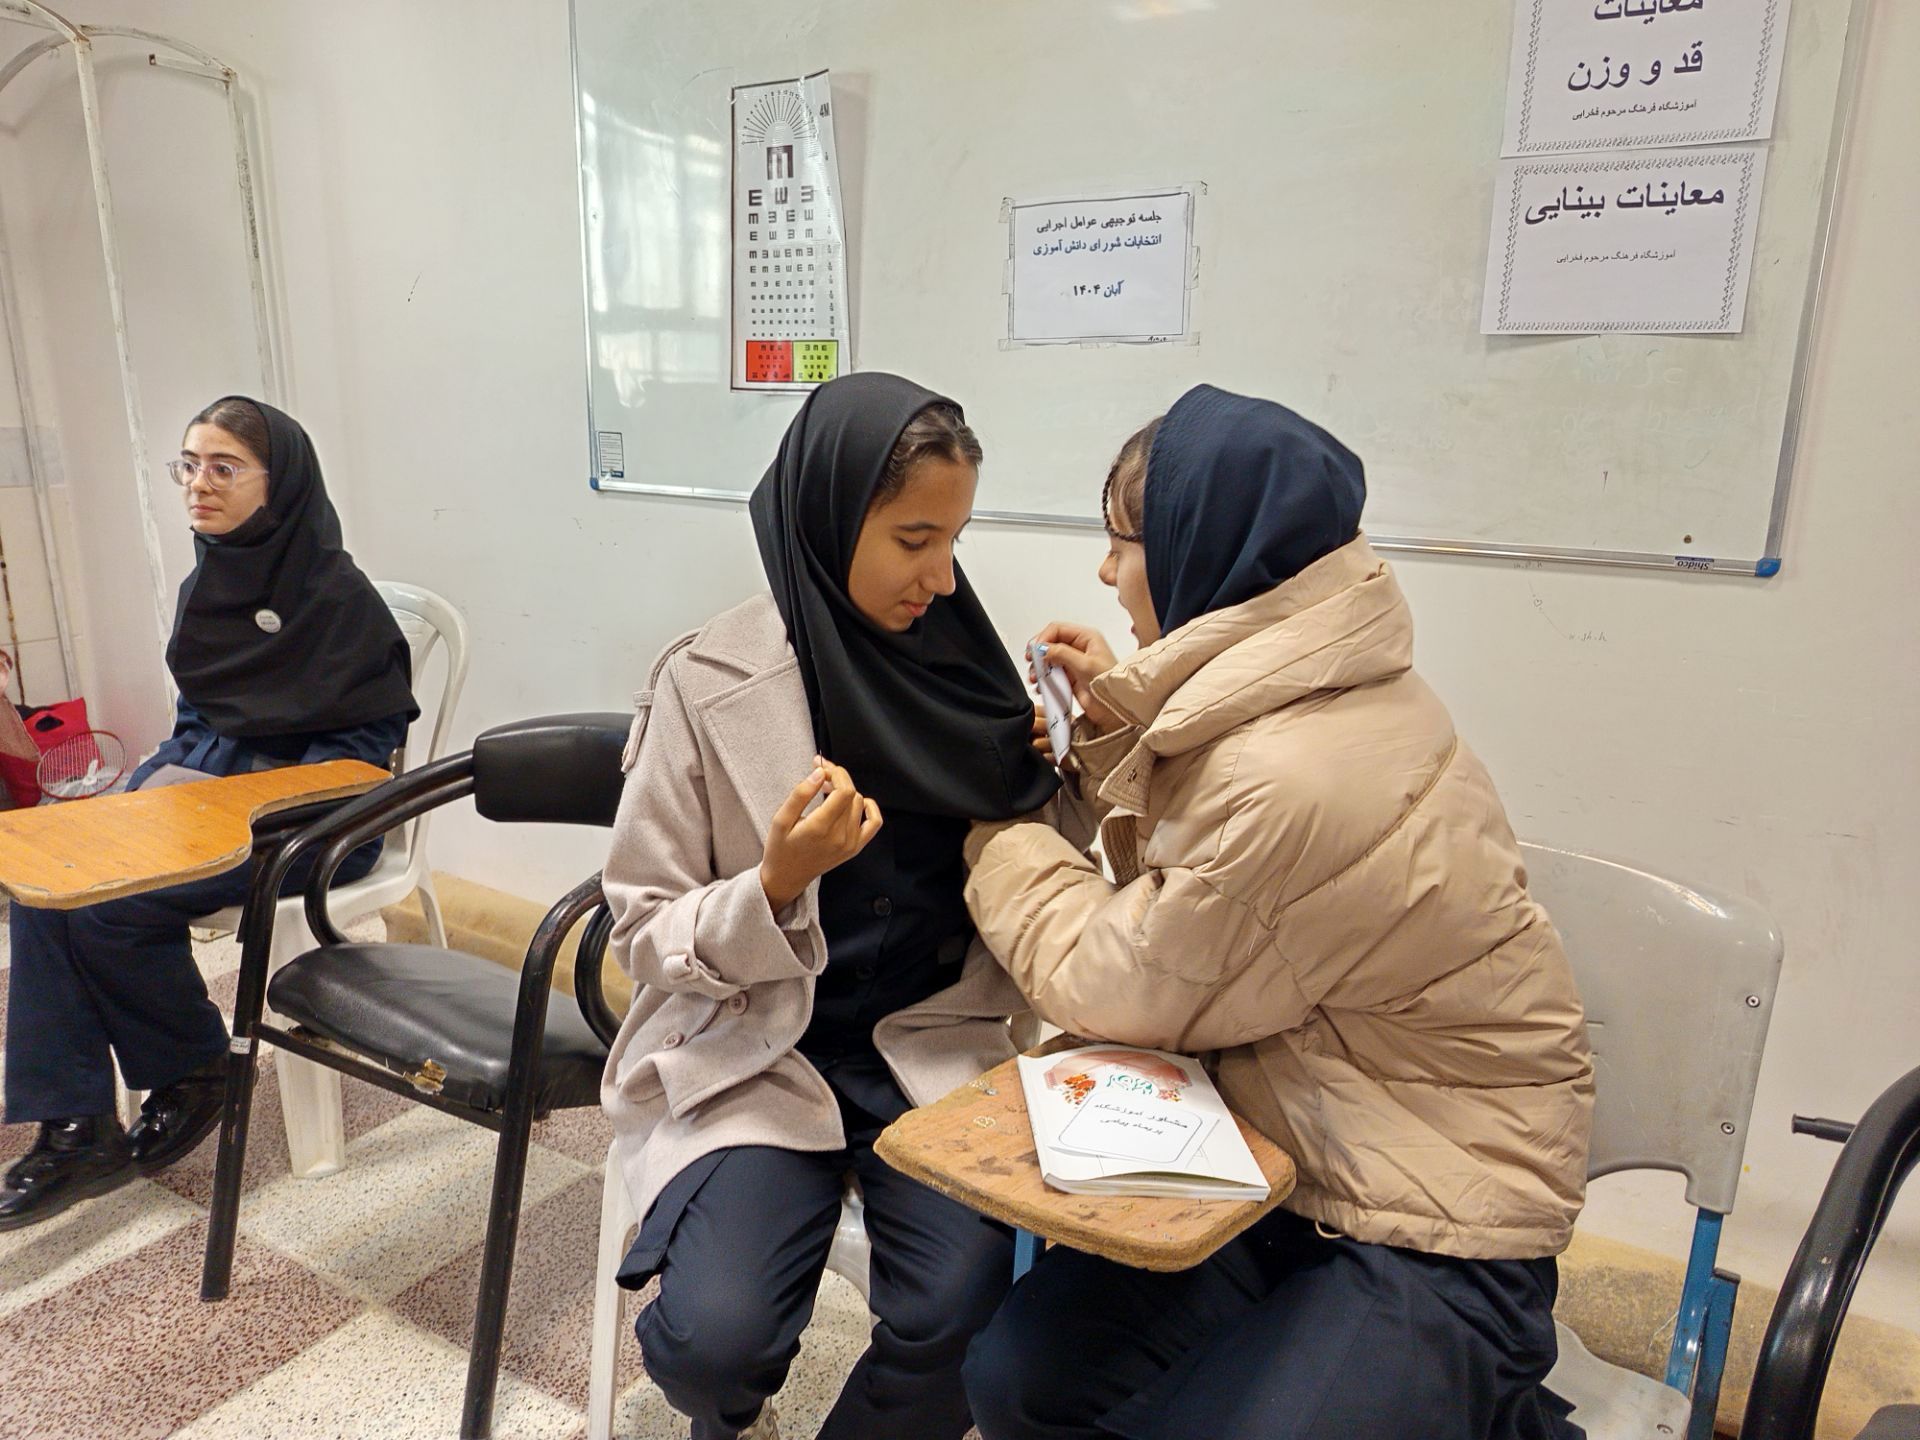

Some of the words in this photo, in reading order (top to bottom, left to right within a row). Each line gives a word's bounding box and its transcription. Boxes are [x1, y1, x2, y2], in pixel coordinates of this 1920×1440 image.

[1673, 40, 1703, 74] قد
[1567, 55, 1630, 91] وزن
[1640, 59, 1661, 86] و
[1600, 107, 1626, 118] مرحوم
[1628, 102, 1656, 114] فرهنگ
[1524, 185, 1605, 224] بینایی
[1616, 181, 1725, 216] معاینات
[1036, 217, 1067, 233] اجرایی
[1070, 215, 1097, 230] عوامل
[1101, 213, 1136, 229] توجیهی
[1138, 210, 1162, 224] جلسه
[1033, 238, 1062, 256] آموزی
[1064, 239, 1087, 254] دانش
[1089, 236, 1121, 252] شورای
[1124, 233, 1162, 249] انتخابات
[1583, 255, 1609, 264] مرحوم
[1611, 251, 1638, 262] فرهنگ
[1073, 284, 1100, 297] ۱۴۰۴
[1103, 280, 1125, 298] آبان
[1677, 560, 1709, 571] Shidco
